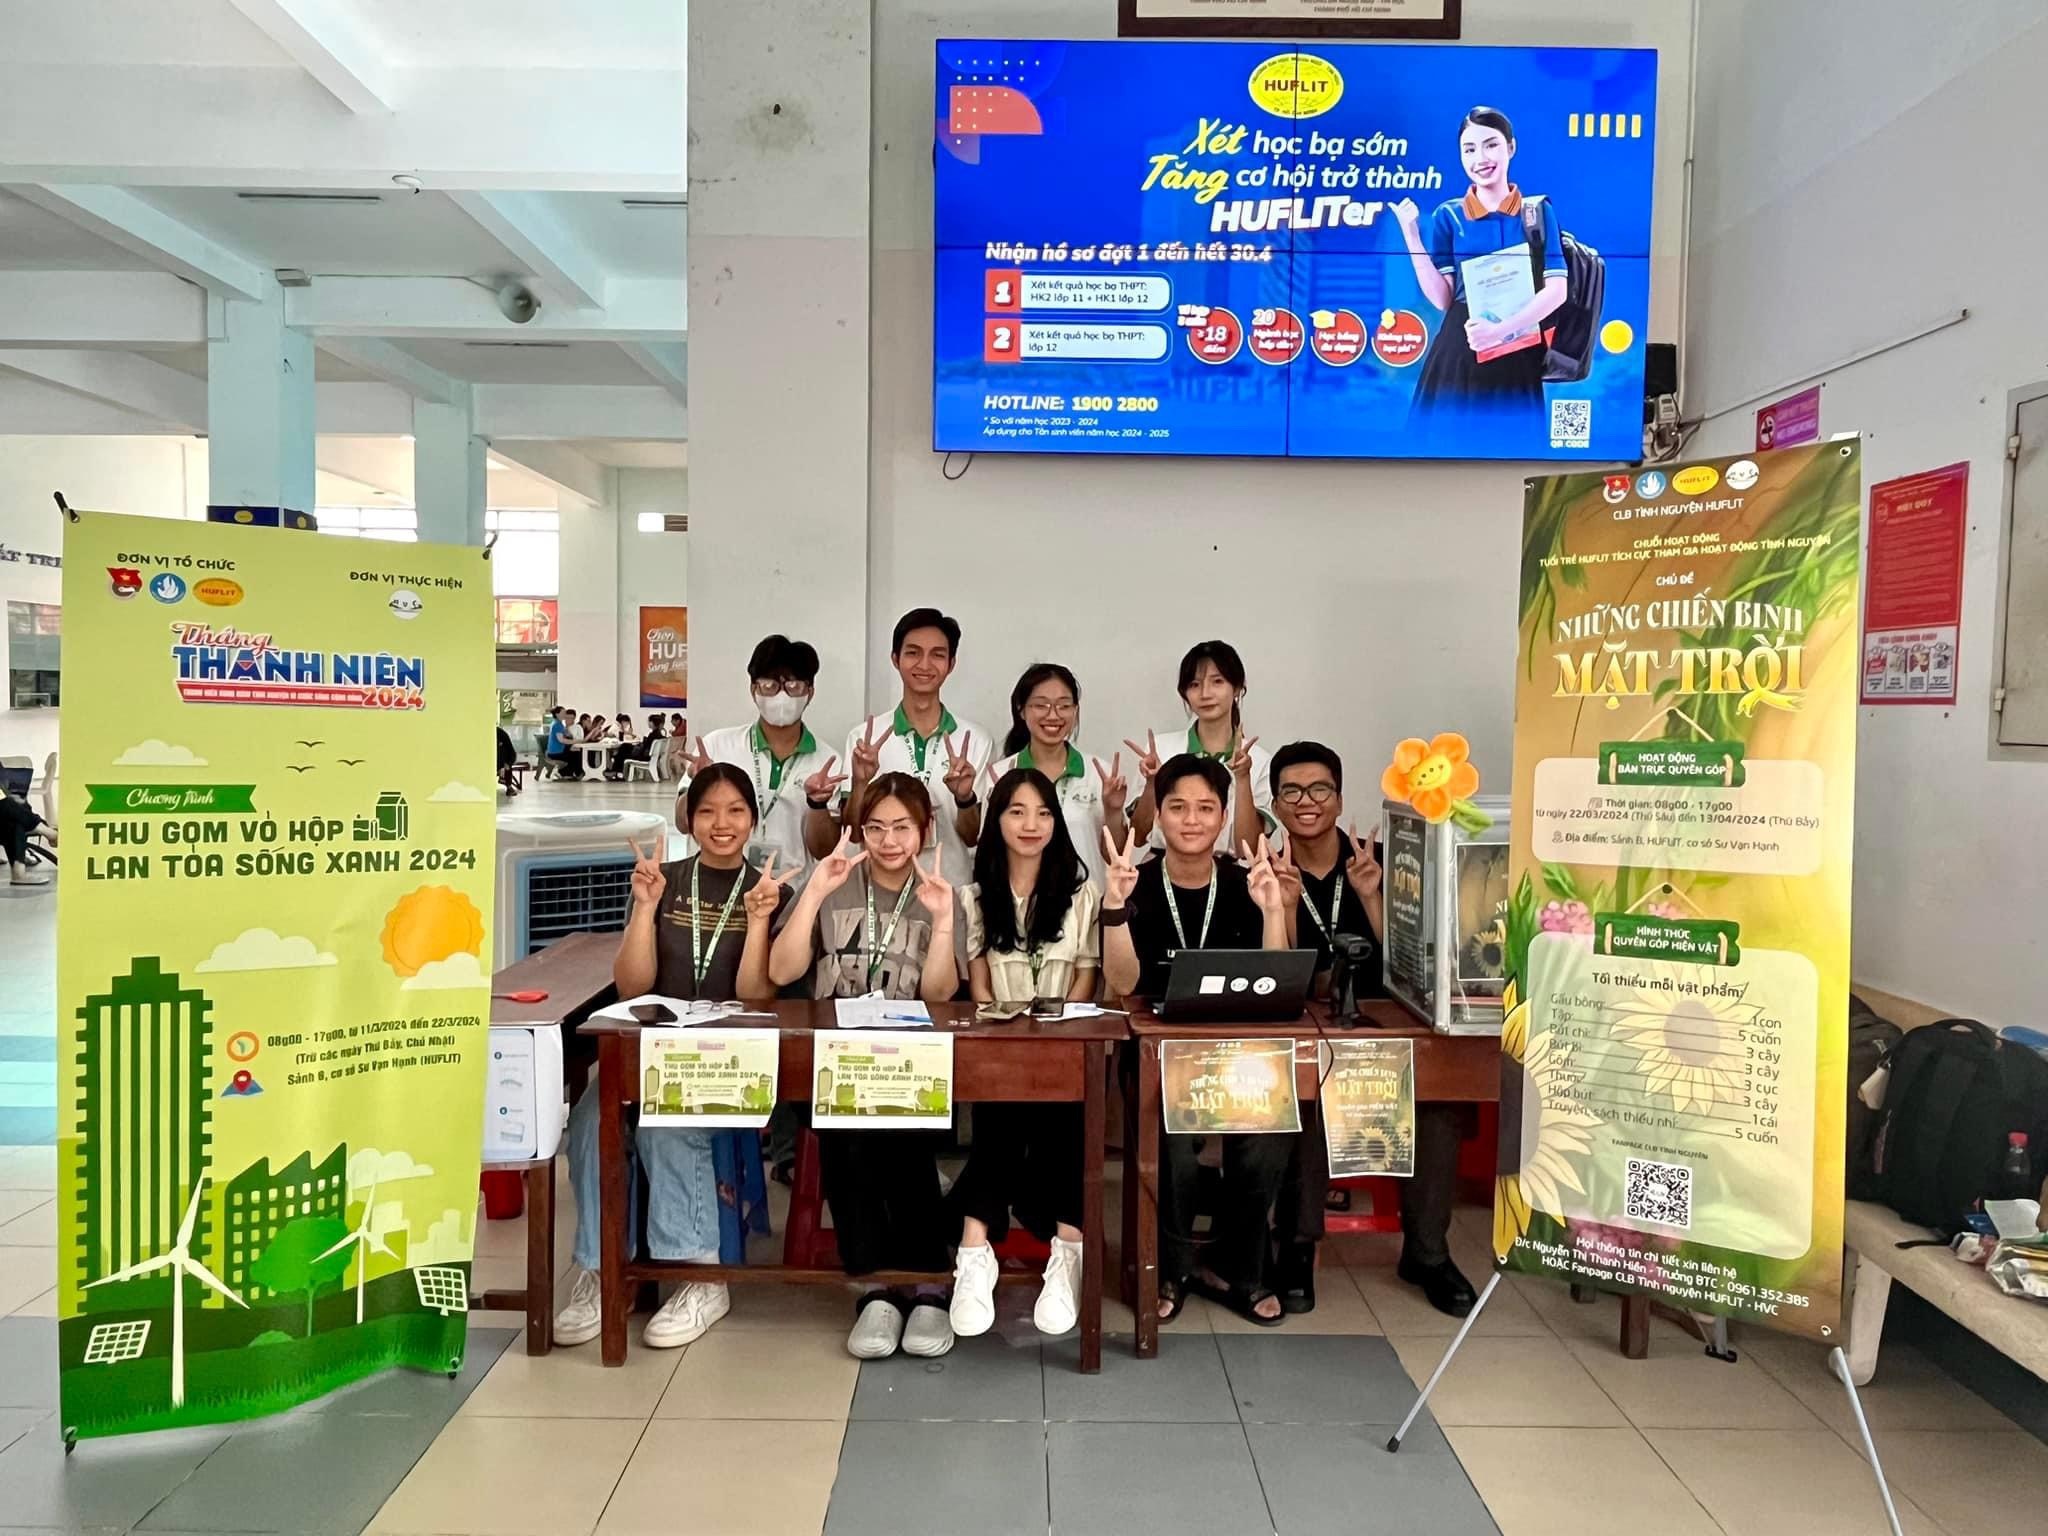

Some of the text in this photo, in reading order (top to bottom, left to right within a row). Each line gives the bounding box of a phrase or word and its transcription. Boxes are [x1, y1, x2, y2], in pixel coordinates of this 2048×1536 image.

[1264, 80, 1328, 92] HUFLIT
[1183, 117, 1408, 162] Xét học bạ sớm
[1141, 153, 1442, 204] Tăng cơ hội trở thành
[1210, 195, 1384, 234] HUFLITer
[985, 241, 1272, 265] Nhận hồ sơ đợt 1 đến hết 30.4
[994, 281, 1012, 304] 1
[1030, 293, 1051, 302] HK2
[1137, 294, 1149, 303] 12
[1252, 309, 1276, 326] 20
[992, 327, 1011, 350] 2
[1046, 343, 1058, 352] 12
[983, 395, 1159, 412] HOTLINE: 1900 2800
[1613, 510, 1632, 520] CLB
[117, 552, 236, 571] ĐƠN VỊ TỔ CHỨC
[349, 571, 463, 590] ĐƠN VỊ THỰC HIỆN
[199, 586, 237, 597] HUFLIT
[1557, 587, 1803, 643] NHỮNG CHIẾN BINH
[171, 621, 279, 655] Tháng
[649, 643, 688, 660] HUF
[172, 646, 425, 688] THANH NIÊN
[1552, 634, 1807, 710] MẶT TRỜI
[364, 687, 425, 709] 2024
[1638, 753, 1666, 765] HOẠT
[126, 788, 215, 810] Chương trình
[1654, 800, 1688, 812] 08g00
[1698, 801, 1733, 813] 17g00
[1568, 809, 1766, 825] 22/03/2024 13/04/2024
[85, 810, 344, 847] THU GOM VỎ HỘP
[86, 844, 477, 880] LAN TỎA SỐNG XANH 2024
[360, 1019, 407, 1036] 11/3/2024
[431, 1015, 480, 1029] 22/3/2024
[1759, 1018, 1782, 1029] con
[1738, 1030, 1781, 1045] 5 cuốn
[1747, 1047, 1781, 1063] 3 cây
[1745, 1063, 1780, 1081] 3 cây
[1744, 1080, 1778, 1096] 3 cục
[1743, 1096, 1778, 1113] 3 cây
[1759, 1115, 1777, 1128] cái
[1735, 1127, 1742, 1138] 5
[1747, 1129, 1778, 1145] cuốn
[1596, 1240, 1626, 1257] thông
[1532, 1240, 1570, 1258] Nguyễn
[1590, 1252, 1621, 1267] Thanh
[1696, 1273, 1718, 1289] BTC
[1727, 1280, 1809, 1308] 0961.352.385
[1572, 1261, 1613, 1280] Fanpage
[1615, 1271, 1635, 1285] CLB
[1662, 1282, 1702, 1300] nguyện
[1704, 1289, 1744, 1308] HUFLIT
[1754, 1300, 1778, 1316] HVC
